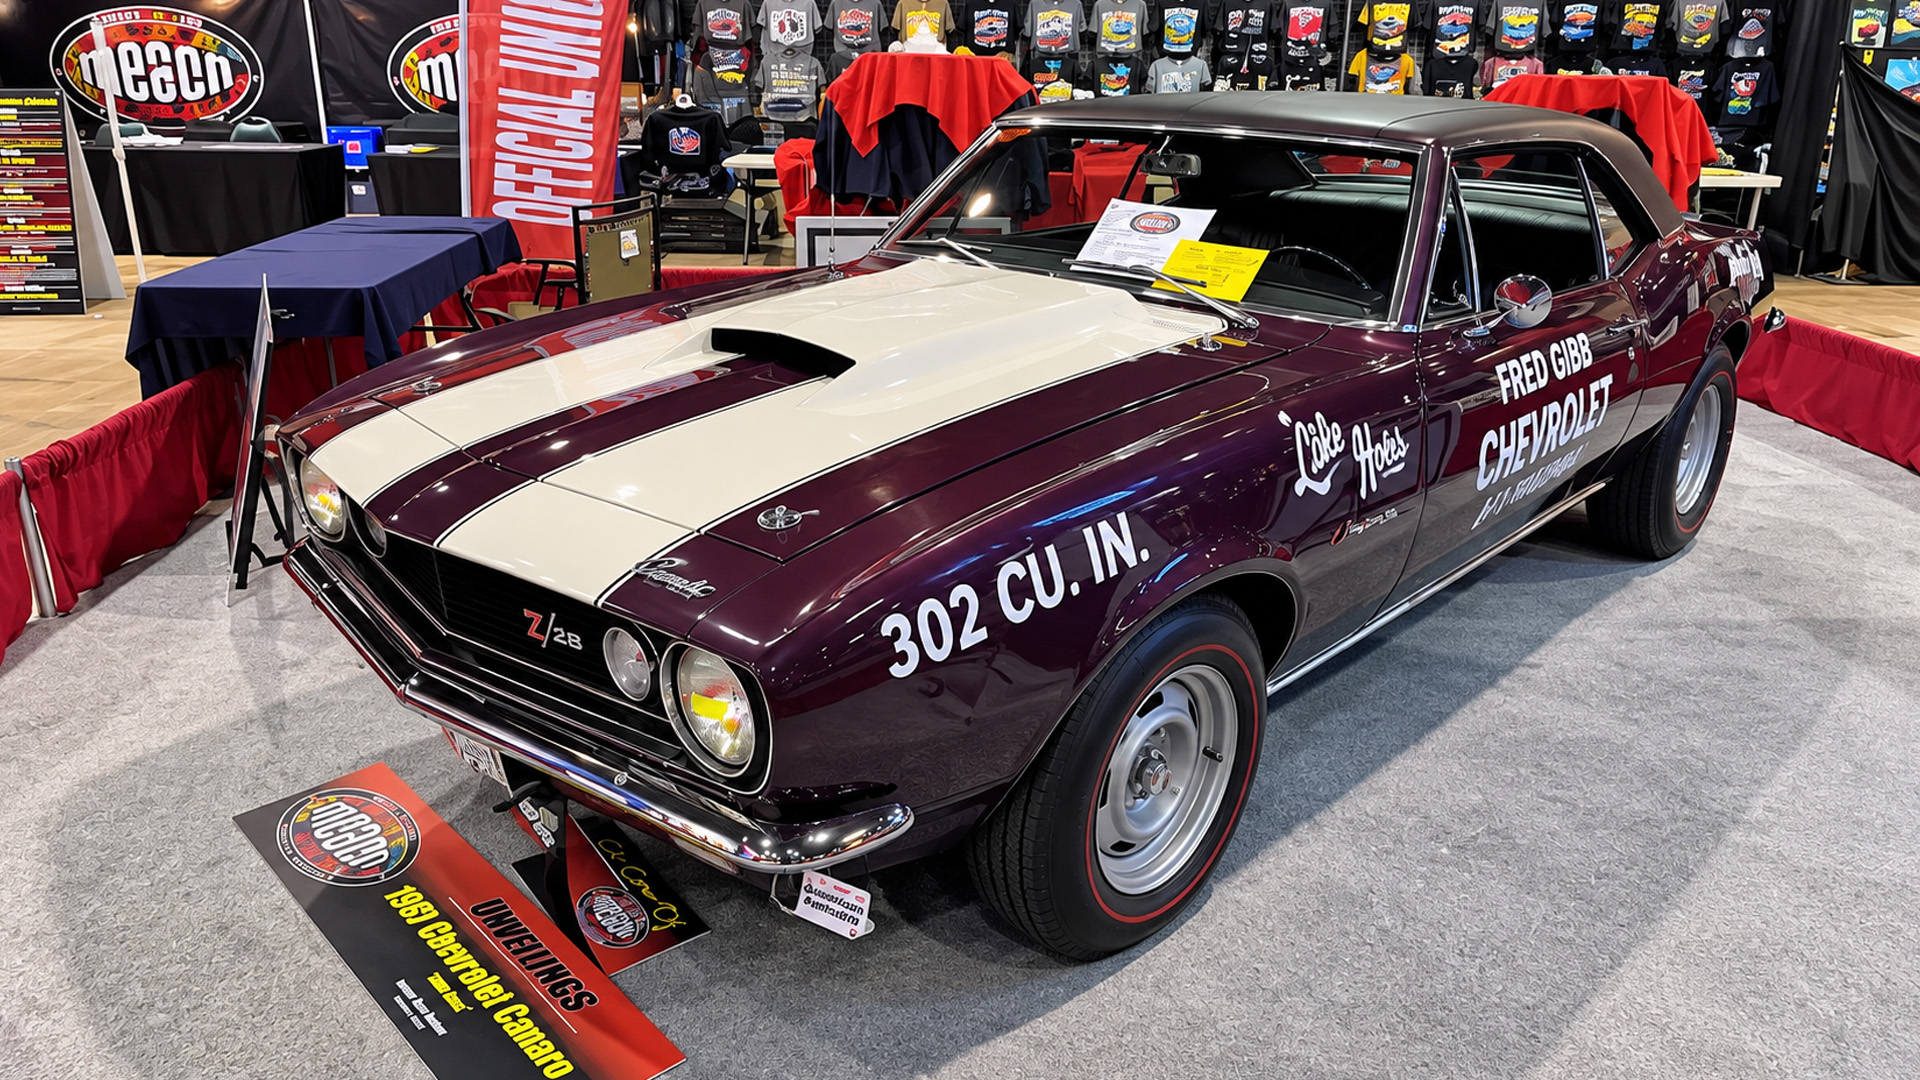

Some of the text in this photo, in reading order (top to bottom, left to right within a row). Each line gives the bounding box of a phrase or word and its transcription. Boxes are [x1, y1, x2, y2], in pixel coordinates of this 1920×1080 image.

[492, 87, 596, 227] OFFICIAL
[1494, 332, 1594, 405] FRED GIBB
[1476, 373, 1614, 492] CHEVROLET
[880, 511, 1150, 678] 302 CU. IN.
[470, 897, 599, 1012] UNVEILINGS
